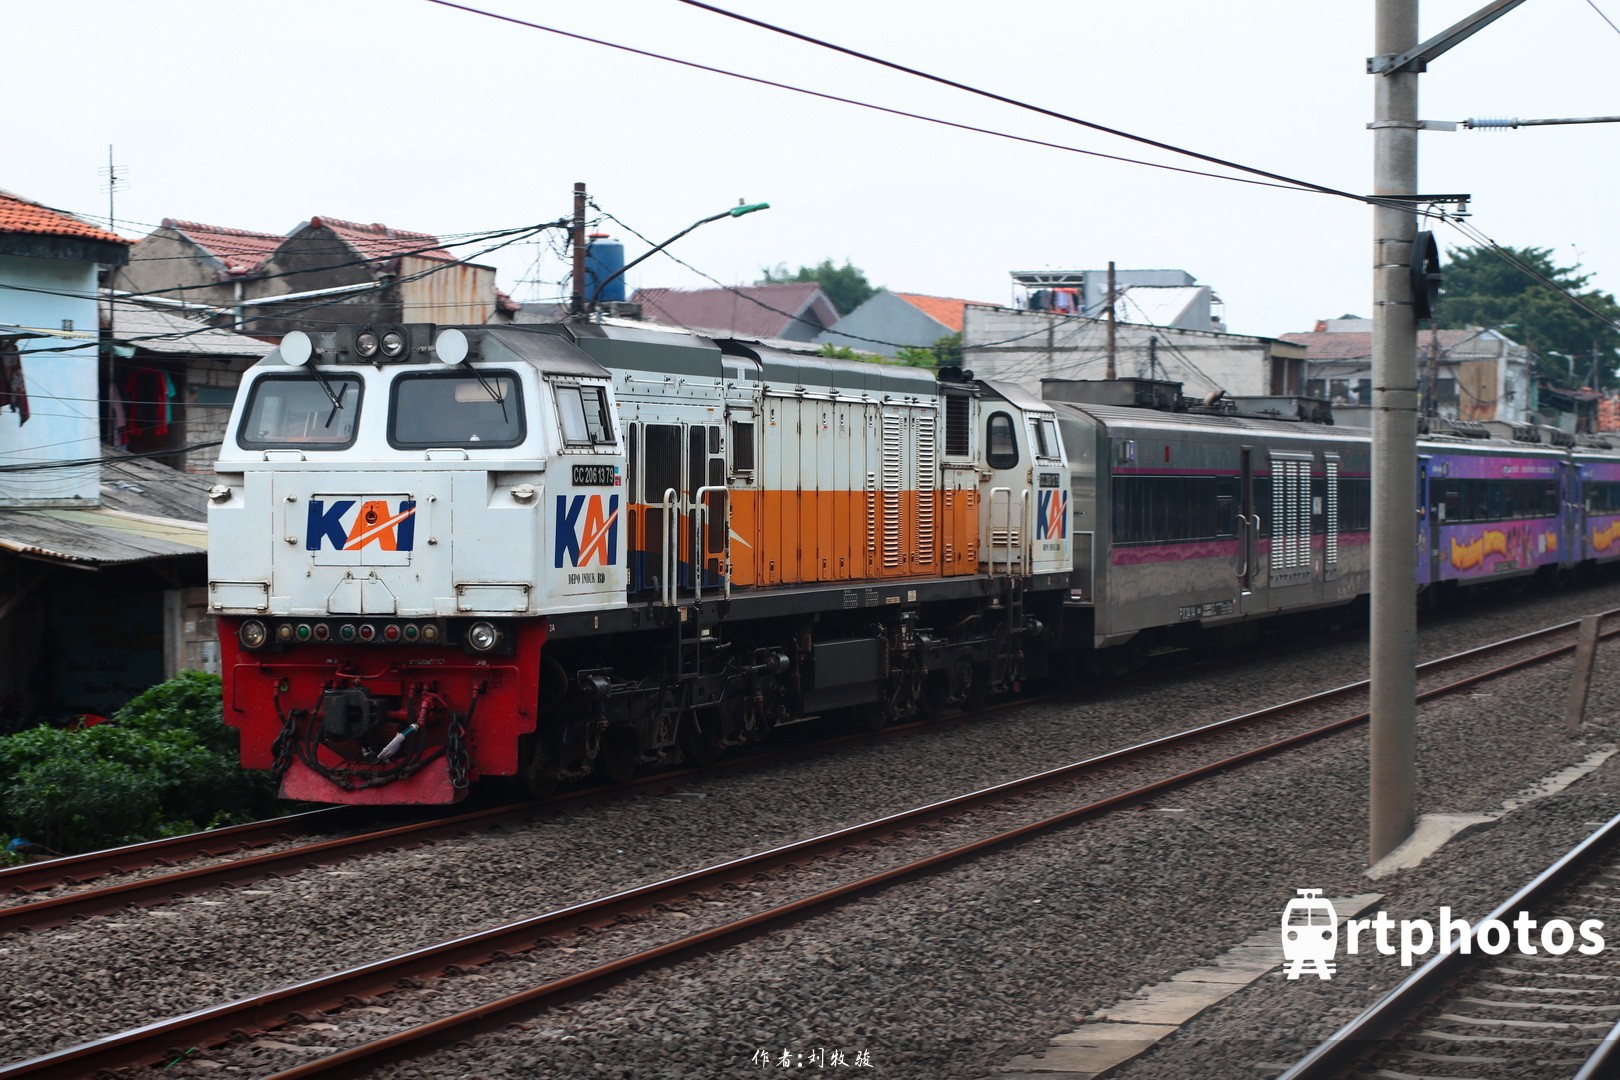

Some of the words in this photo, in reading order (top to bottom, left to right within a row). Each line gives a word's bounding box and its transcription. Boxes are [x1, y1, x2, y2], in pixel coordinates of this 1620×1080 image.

[573, 467, 584, 483] CC
[585, 467, 598, 483] 206
[598, 467, 605, 483] 13
[605, 467, 614, 483] 79
[306, 500, 417, 551] KAI
[554, 494, 619, 568] KAI
[1037, 490, 1067, 540] KAI
[568, 573, 581, 585] DEPO
